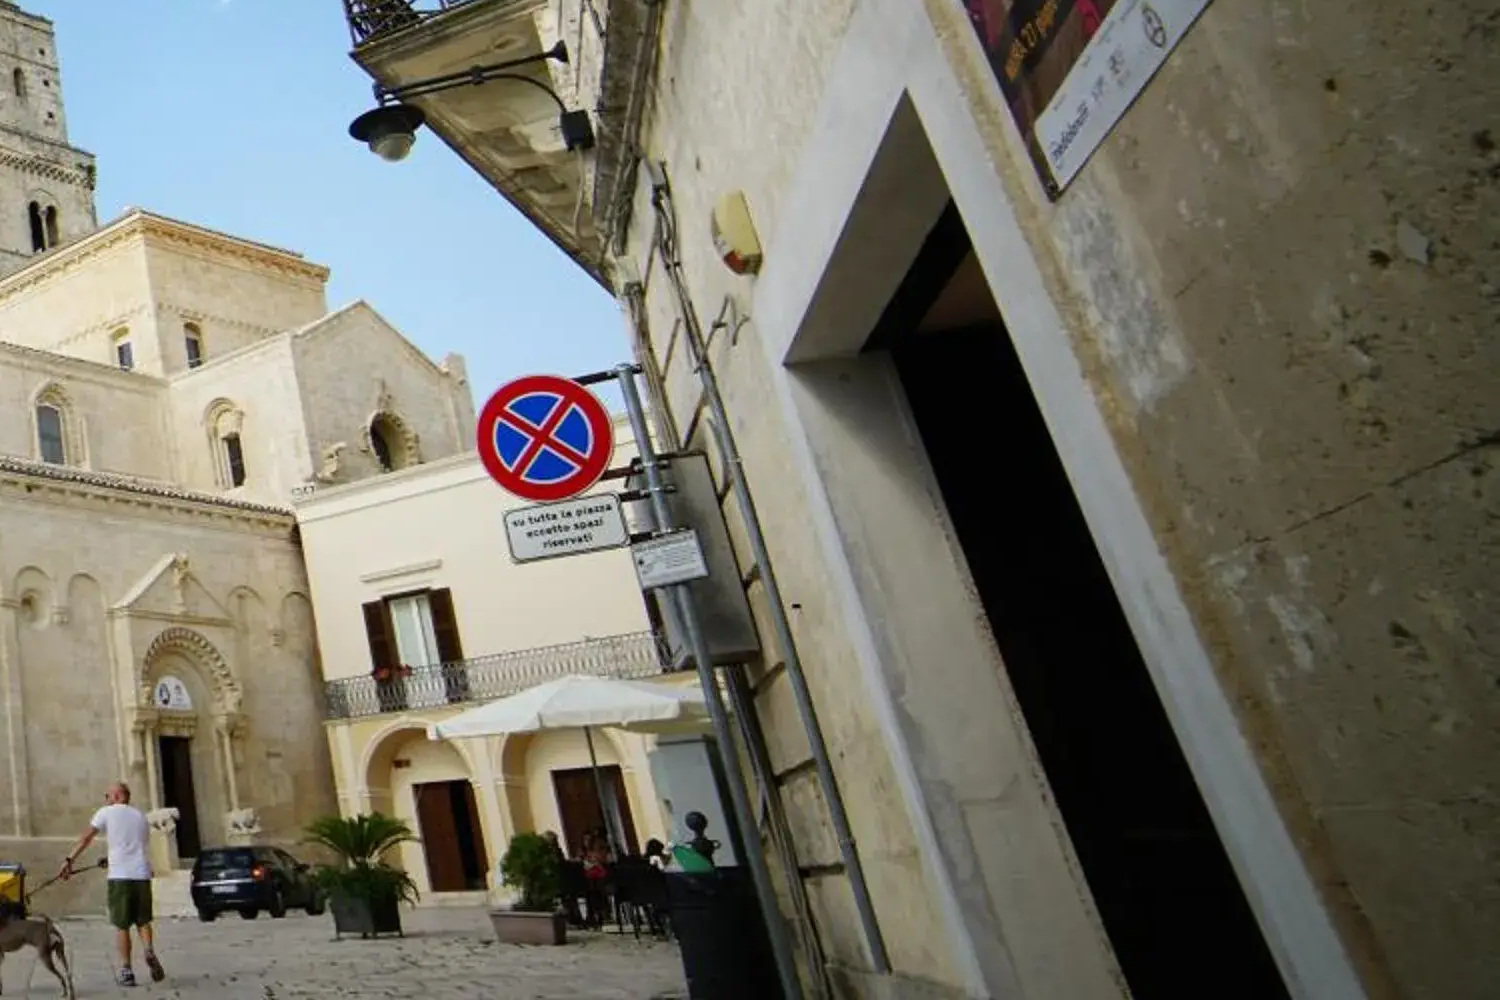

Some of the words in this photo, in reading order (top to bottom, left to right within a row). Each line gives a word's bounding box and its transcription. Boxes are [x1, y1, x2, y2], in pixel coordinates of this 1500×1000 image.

[512, 518, 525, 528] su
[528, 512, 558, 525] tutta
[561, 509, 573, 518] la
[575, 503, 613, 517] piazza
[526, 523, 571, 538] eccetto
[573, 516, 604, 530] spazi
[543, 532, 593, 548] riservati
